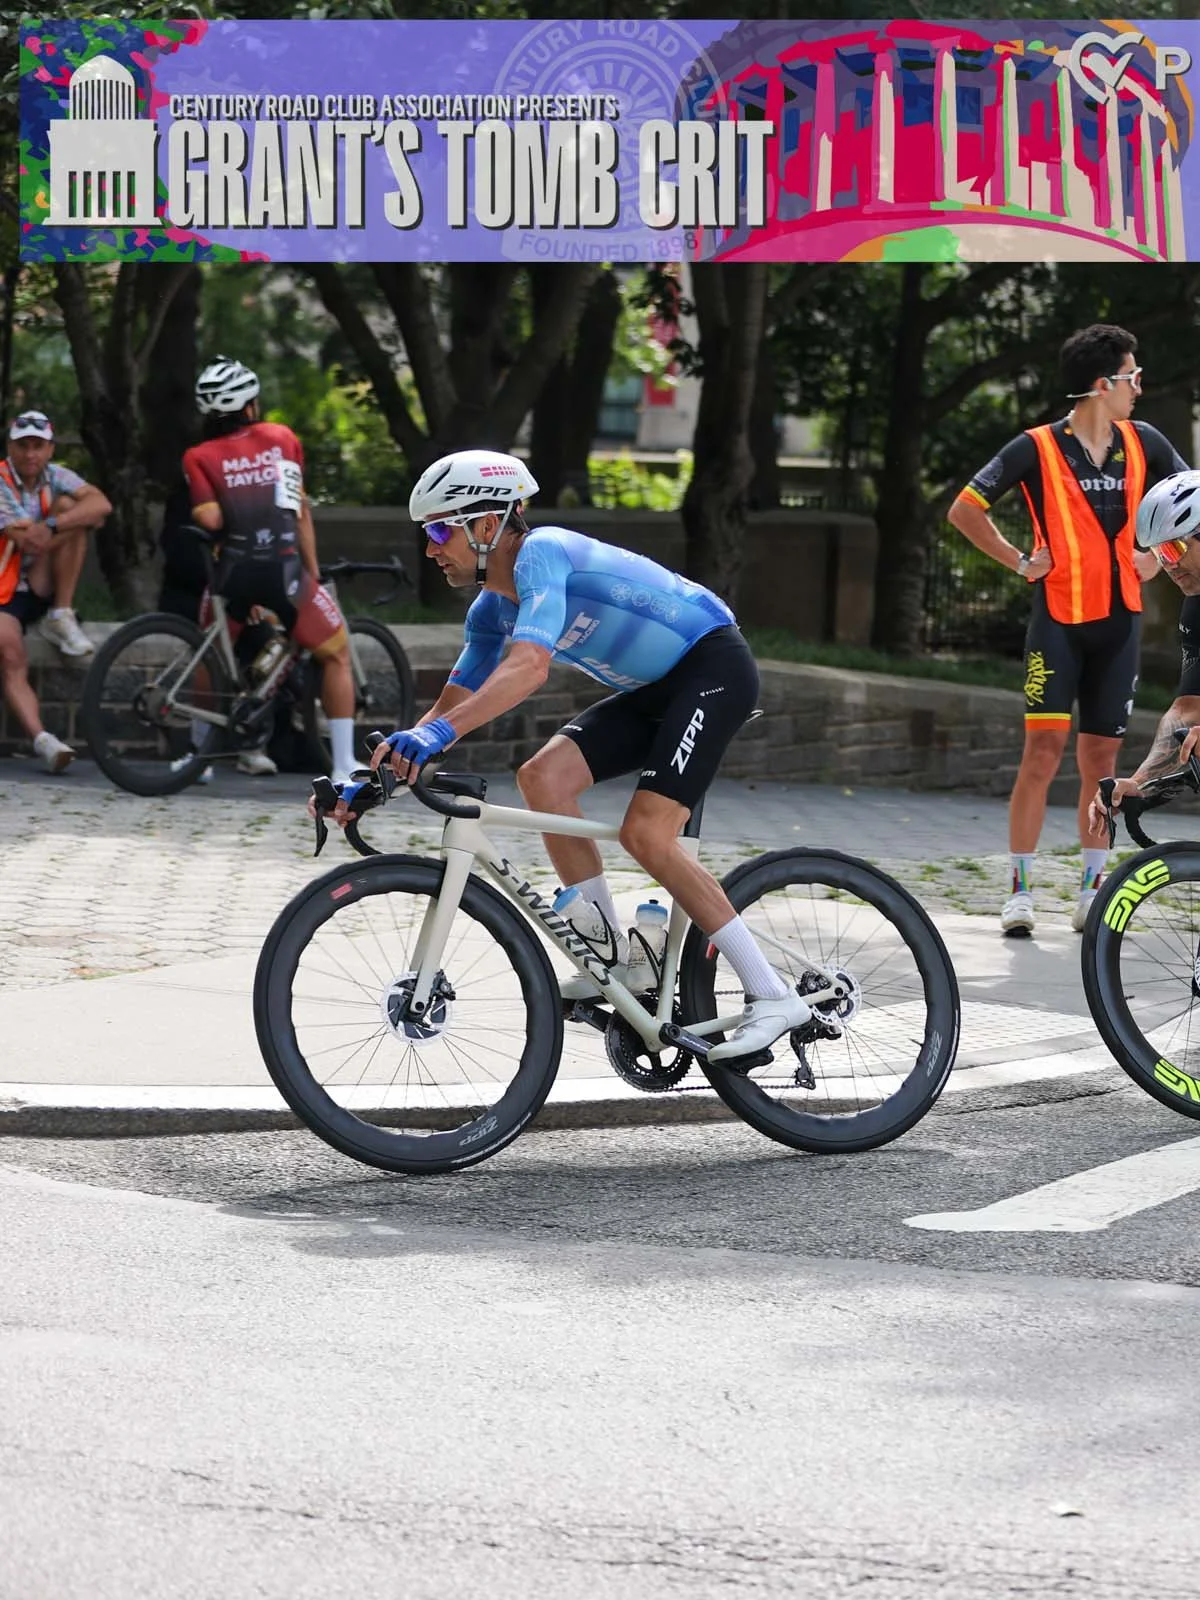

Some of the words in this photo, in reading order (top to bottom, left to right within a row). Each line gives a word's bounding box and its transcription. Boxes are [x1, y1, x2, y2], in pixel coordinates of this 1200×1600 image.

[222, 446, 283, 473] MAJOR
[224, 466, 280, 489] TAYLO
[444, 484, 513, 497] ZIPP
[670, 707, 705, 776] ZIPP
[489, 857, 611, 986] S-WORKS
